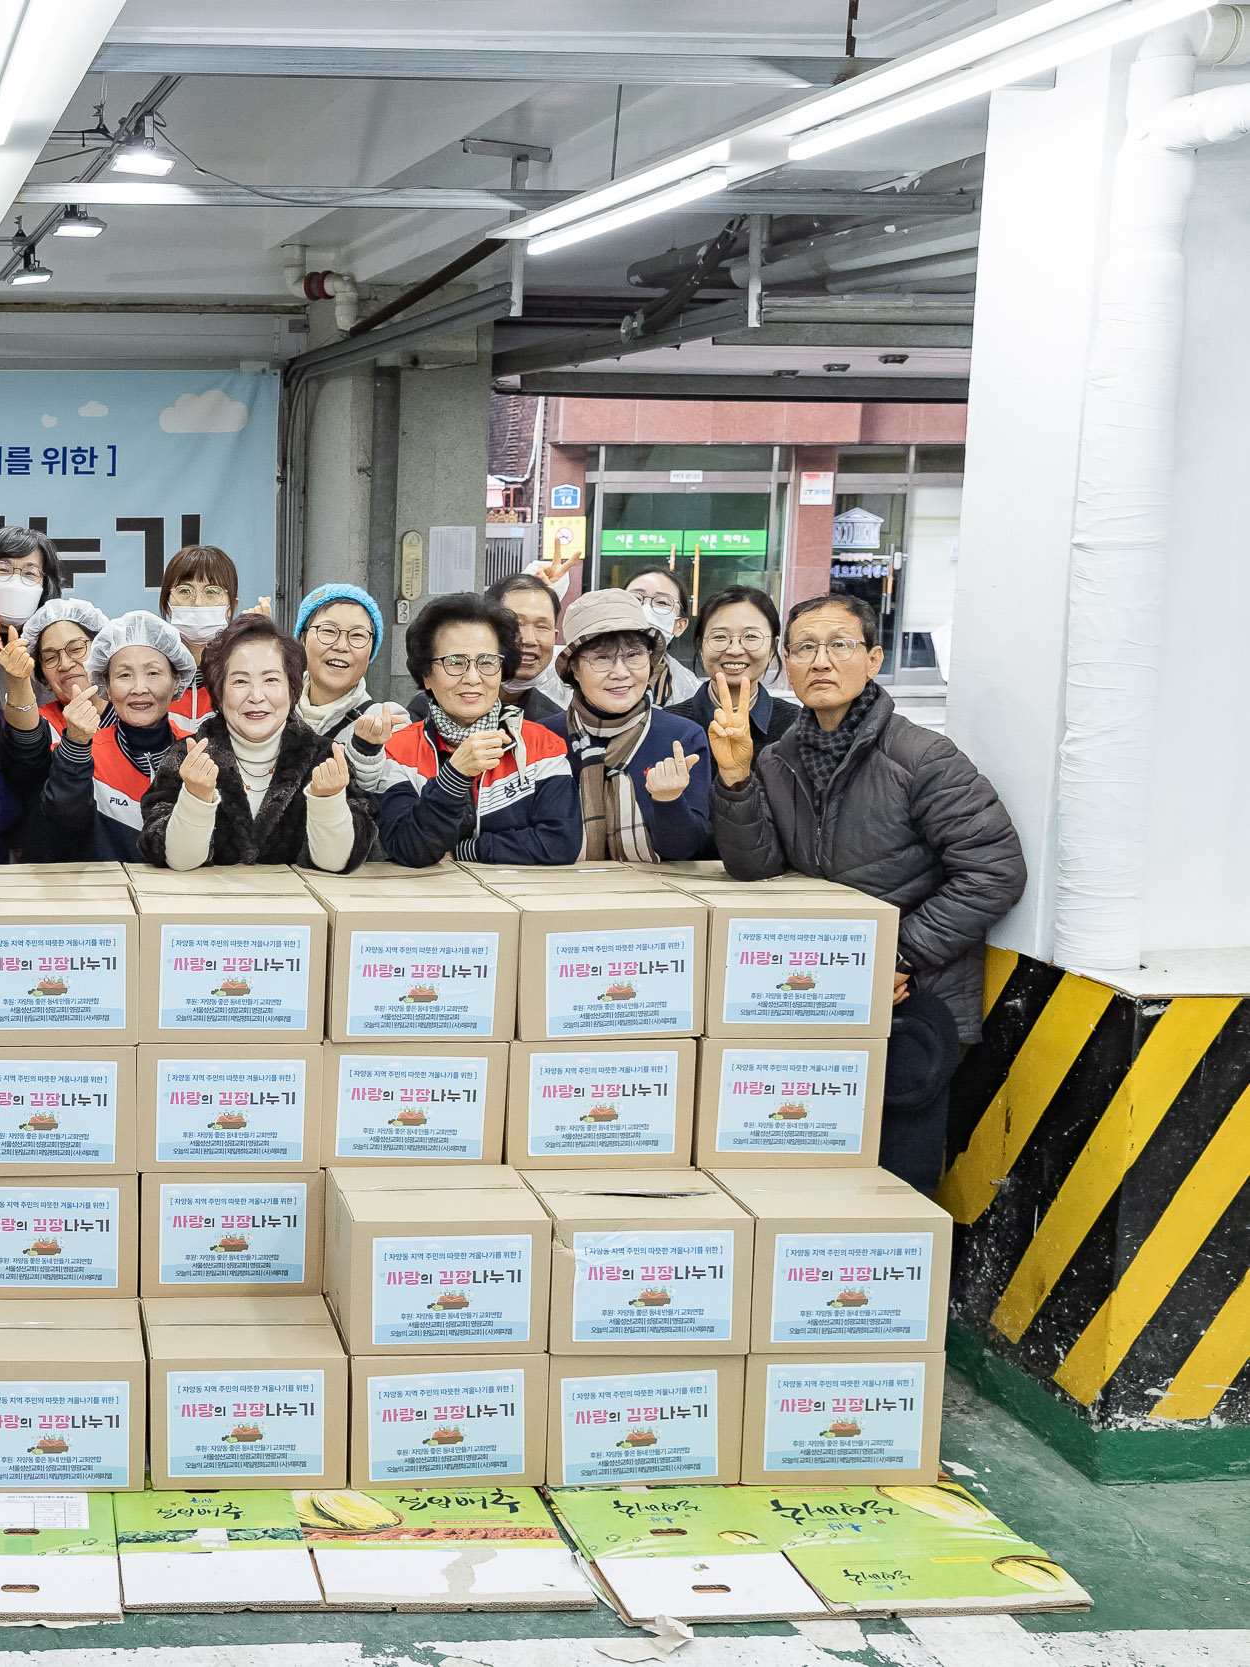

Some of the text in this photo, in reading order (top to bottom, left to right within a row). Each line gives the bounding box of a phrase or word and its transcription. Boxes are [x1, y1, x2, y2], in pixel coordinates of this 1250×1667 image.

[41, 445, 99, 476] 위한
[560, 495, 573, 506] 14
[109, 796, 129, 807] FILA
[173, 957, 299, 971] 사랑의 김장나누기
[739, 951, 865, 965] 사랑의 김장나누기
[362, 964, 487, 978] 사랑의 김장나누기
[542, 1083, 667, 1098] 사랑의 김장나누기
[170, 1092, 295, 1105] 사랑의 김장나누기
[588, 1265, 723, 1280] 사랑의 김장나누기
[383, 1390, 402, 1398] 자양동
[404, 1389, 418, 1397] 지역
[419, 1388, 438, 1396] 주민의
[440, 1387, 460, 1395] 따뜻한
[462, 1386, 494, 1394] 겨울나기를
[779, 1397, 913, 1412] 사랑의 김장나누기
[382, 1403, 514, 1422] 사랑의 김장나누기
